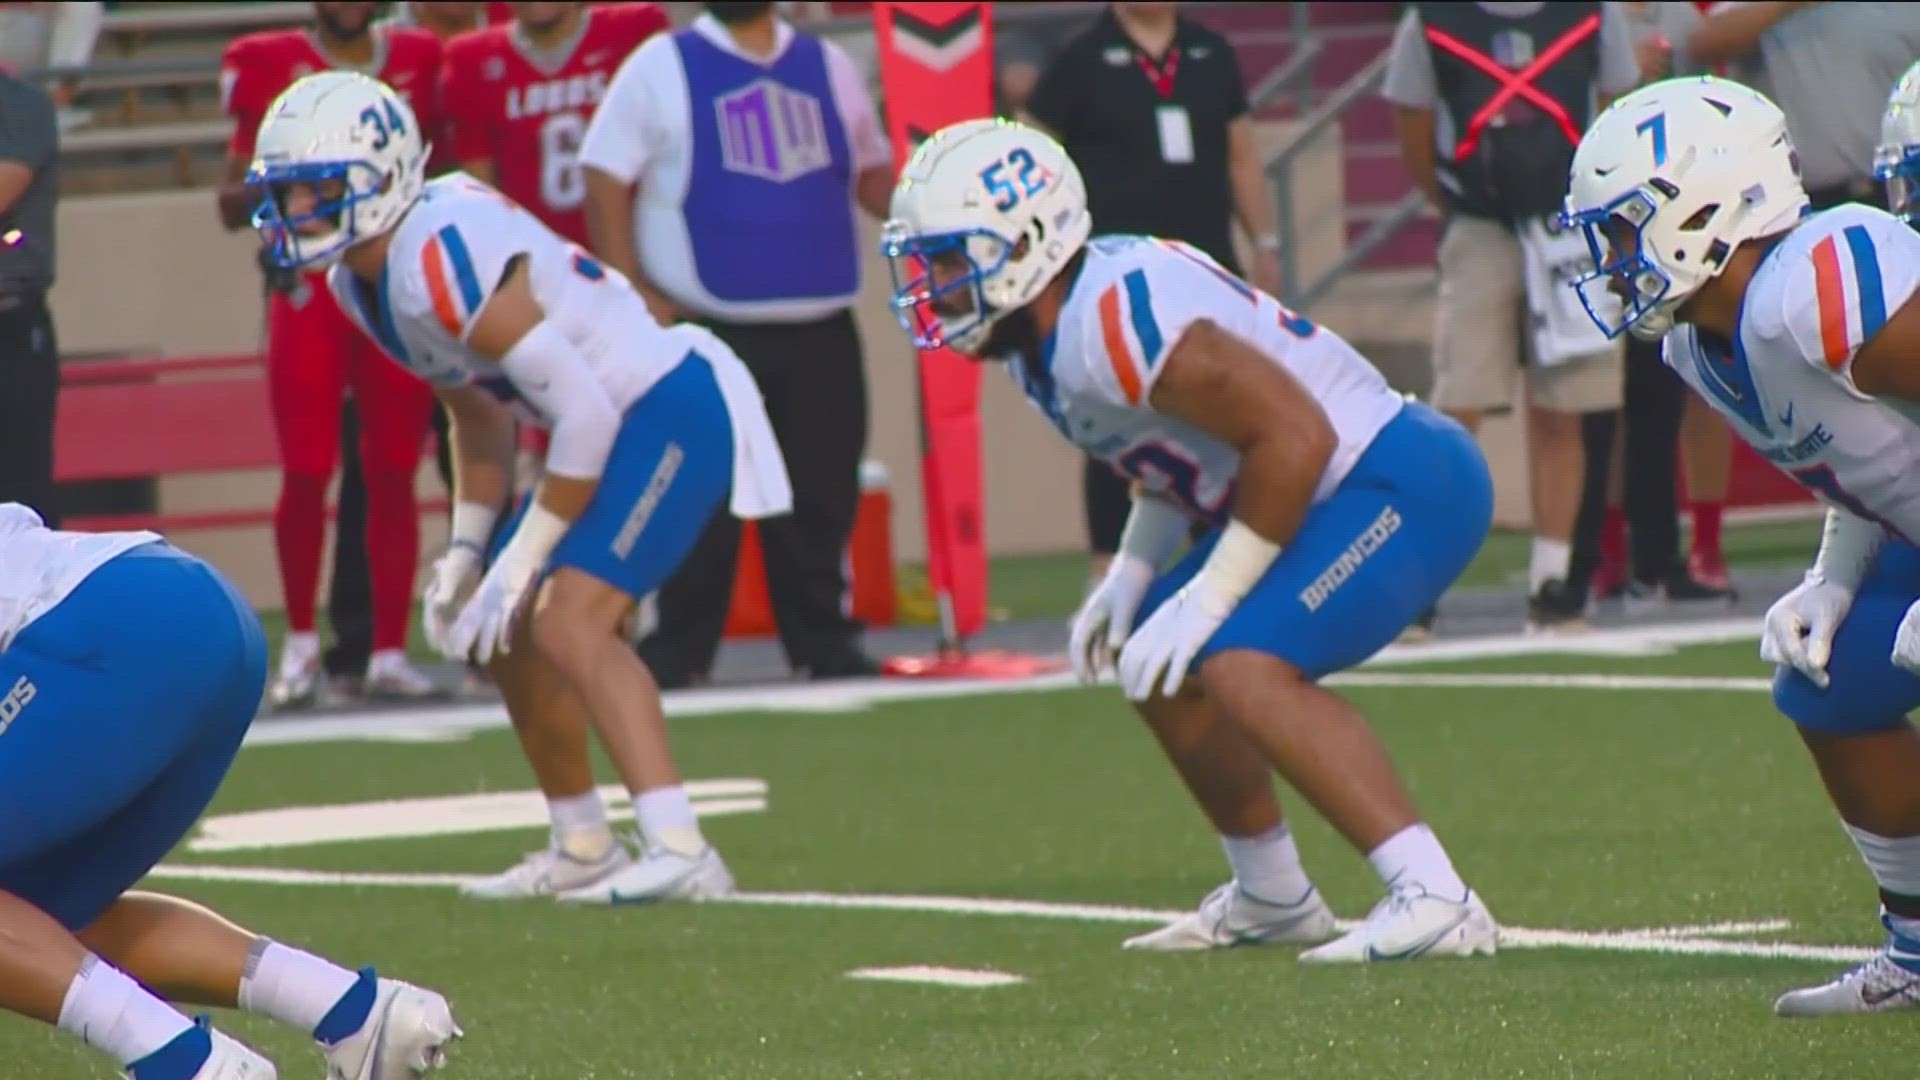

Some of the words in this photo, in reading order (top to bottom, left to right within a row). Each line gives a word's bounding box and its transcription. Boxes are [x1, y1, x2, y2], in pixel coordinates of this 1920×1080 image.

[360, 96, 406, 151] 34
[506, 70, 606, 119] LOBOS
[540, 113, 588, 210] 6
[1635, 110, 1667, 168] 7
[980, 147, 1047, 213] 52
[1299, 505, 1402, 613] BRONCOS
